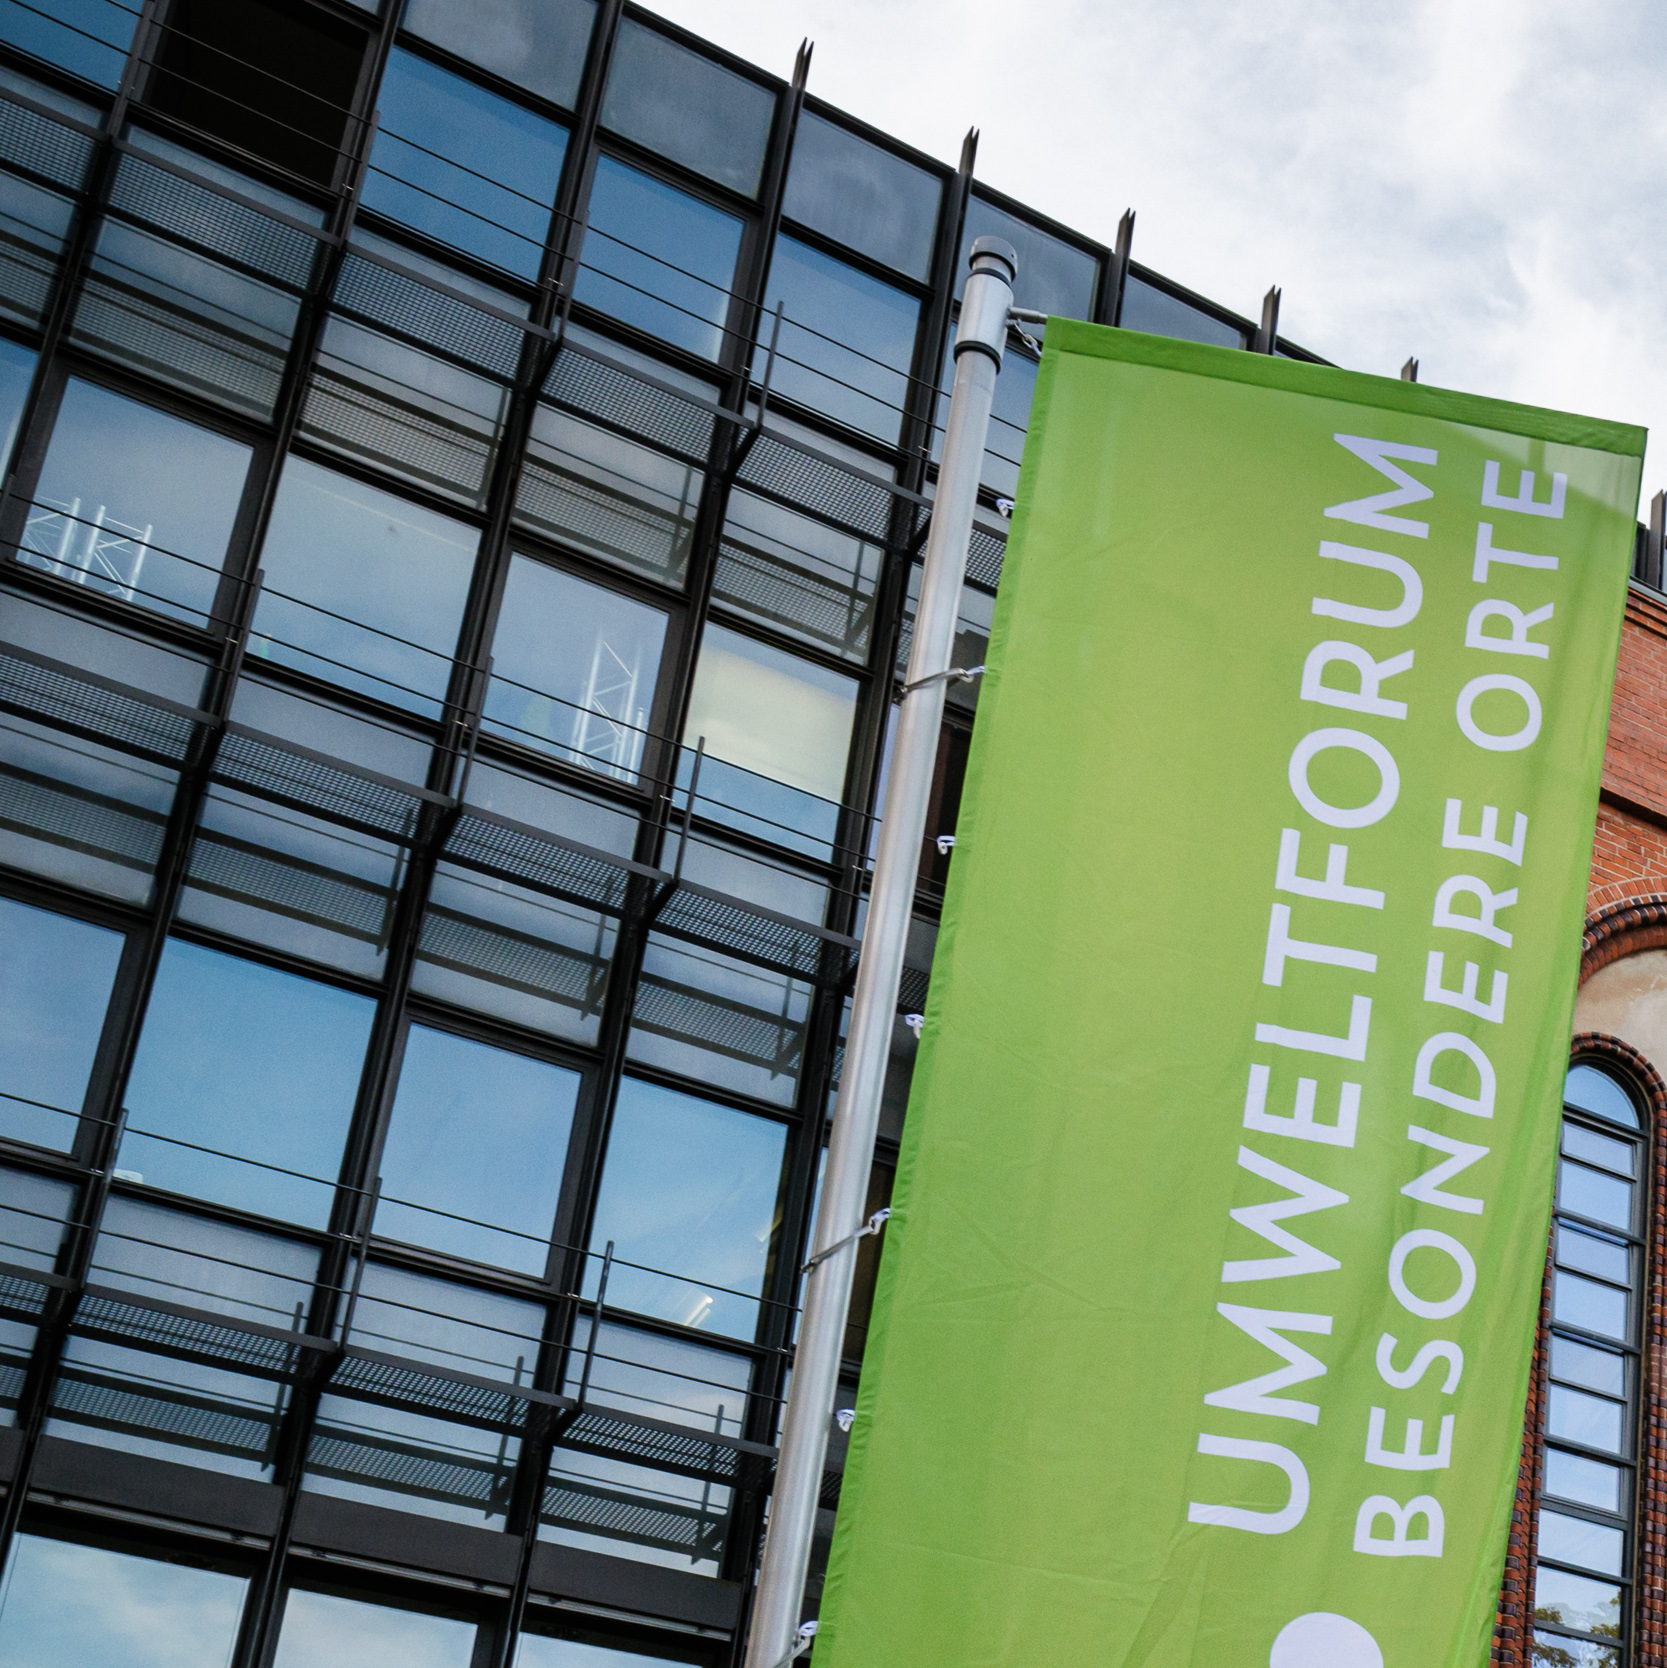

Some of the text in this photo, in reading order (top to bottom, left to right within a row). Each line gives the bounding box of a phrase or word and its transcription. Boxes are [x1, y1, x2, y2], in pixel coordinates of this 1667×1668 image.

[1187, 432, 1438, 1535] UMWELTFORUM
[1352, 459, 1568, 1558] BESONDERE ORTE
